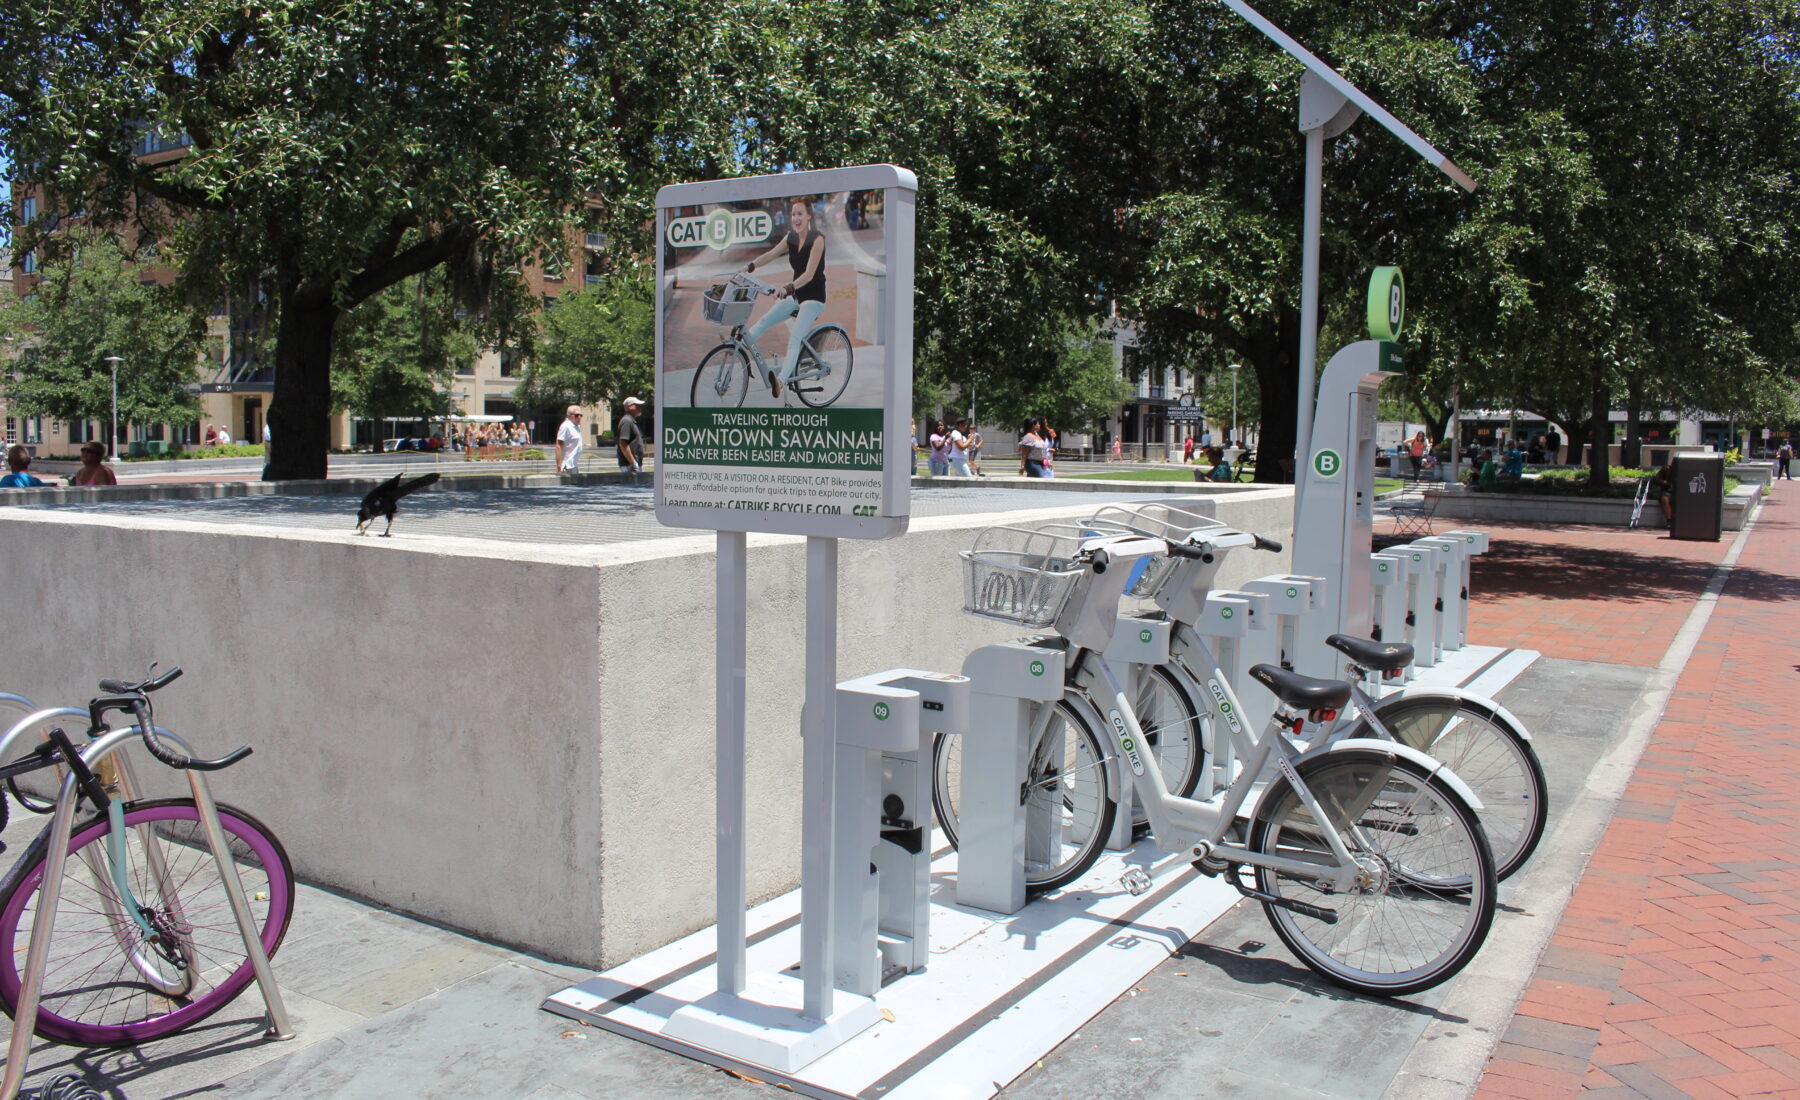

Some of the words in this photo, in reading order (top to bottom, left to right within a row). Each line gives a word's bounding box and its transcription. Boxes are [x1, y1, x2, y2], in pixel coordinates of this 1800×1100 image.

[671, 221, 706, 242] CAT
[1390, 284, 1400, 324] B
[711, 413, 769, 426] TRAVELING
[771, 414, 828, 427] THROUGH
[664, 427, 774, 447] DOWNTOWN
[780, 429, 883, 450] SAVANNAH
[664, 447, 684, 459] HAS
[687, 448, 720, 461] NEVER
[722, 449, 748, 461] BEEN
[751, 449, 786, 463] EASIER
[788, 451, 814, 464] AND
[817, 451, 851, 465] MORE
[854, 453, 882, 466] FUN!
[1320, 455, 1334, 471] B
[664, 471, 697, 480] WHETHER
[698, 472, 722, 481] YOU'RE
[724, 473, 729, 481] A
[730, 473, 757, 482] VISITOR
[758, 474, 769, 483] OR
[770, 475, 776, 483] A
[777, 475, 814, 486] RESIDENT,
[815, 476, 830, 486] CAT
[831, 477, 847, 487] Bike
[848, 478, 882, 488] provides
[664, 482, 673, 490] an
[674, 483, 691, 492] easy,
[692, 482, 728, 493] affordable
[730, 484, 753, 494] option
[755, 484, 766, 494] for
[767, 485, 788, 495] quick
[789, 486, 807, 497] trips
[808, 488, 817, 496] to
[818, 488, 848, 500] explore
[849, 490, 863, 499] our
[727, 499, 841, 515] CATBIKEBCYCLECOM
[852, 504, 878, 516] CAT
[1211, 684, 1225, 702] CAT
[875, 706, 888, 717] 09
[1113, 717, 1128, 739] CAT
